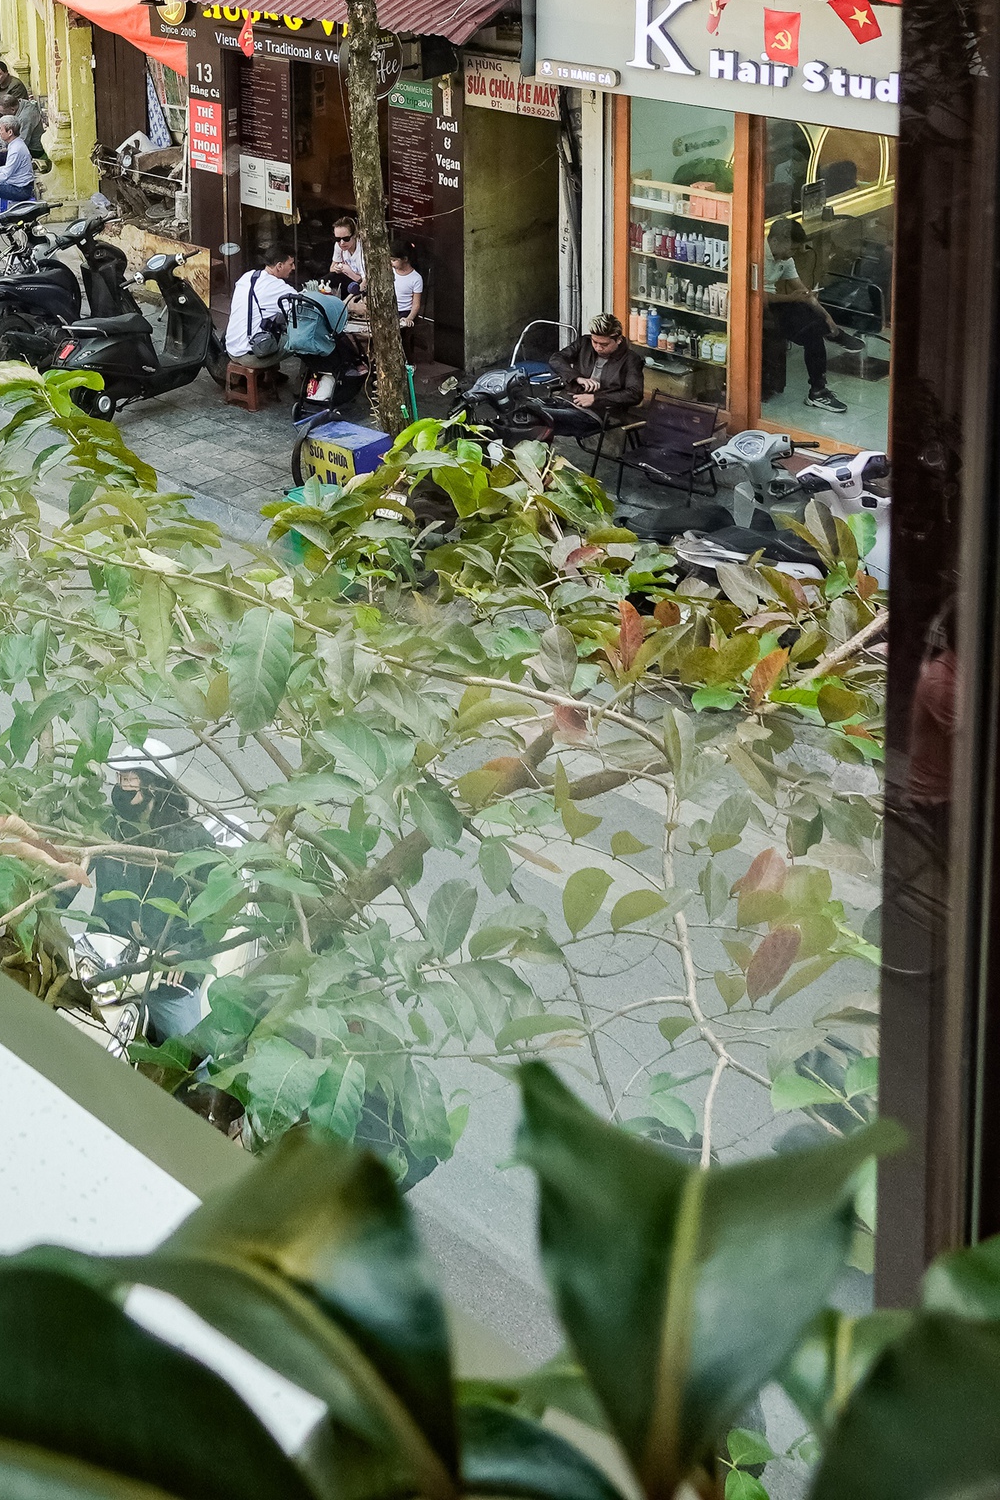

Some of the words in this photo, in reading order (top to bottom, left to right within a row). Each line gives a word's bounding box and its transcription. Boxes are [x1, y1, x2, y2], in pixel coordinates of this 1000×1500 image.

[160, 23, 179, 36] Since
[180, 27, 197, 38] 2006
[265, 39, 313, 59] Traditional
[314, 49, 322, 61] &
[196, 62, 213, 83] 13
[475, 57, 503, 72] HÙNG
[557, 67, 569, 79] 15
[570, 68, 596, 83] HÀNG
[598, 71, 612, 85] CÁ
[709, 49, 793, 88] Hair
[802, 60, 900, 104] Stud
[190, 84, 209, 99] Hàng
[210, 88, 220, 99] Cá
[395, 84, 433, 97] ECOMMENDED
[467, 69, 487, 97] SỬA
[489, 73, 515, 102] CHỮA
[517, 81, 532, 104] XE
[533, 82, 558, 108] MÁY
[196, 104, 214, 119] THẺ
[490, 100, 503, 109] ĐT:
[522, 105, 536, 115] 493
[537, 108, 555, 118] 6226
[194, 120, 217, 137] ĐIỆN
[436, 117, 459, 134] Local
[192, 138, 220, 156] THOẠI
[443, 136, 452, 150] &
[436, 153, 461, 171] Vegan
[438, 172, 459, 189] Food
[309, 441, 325, 461] SỬA
